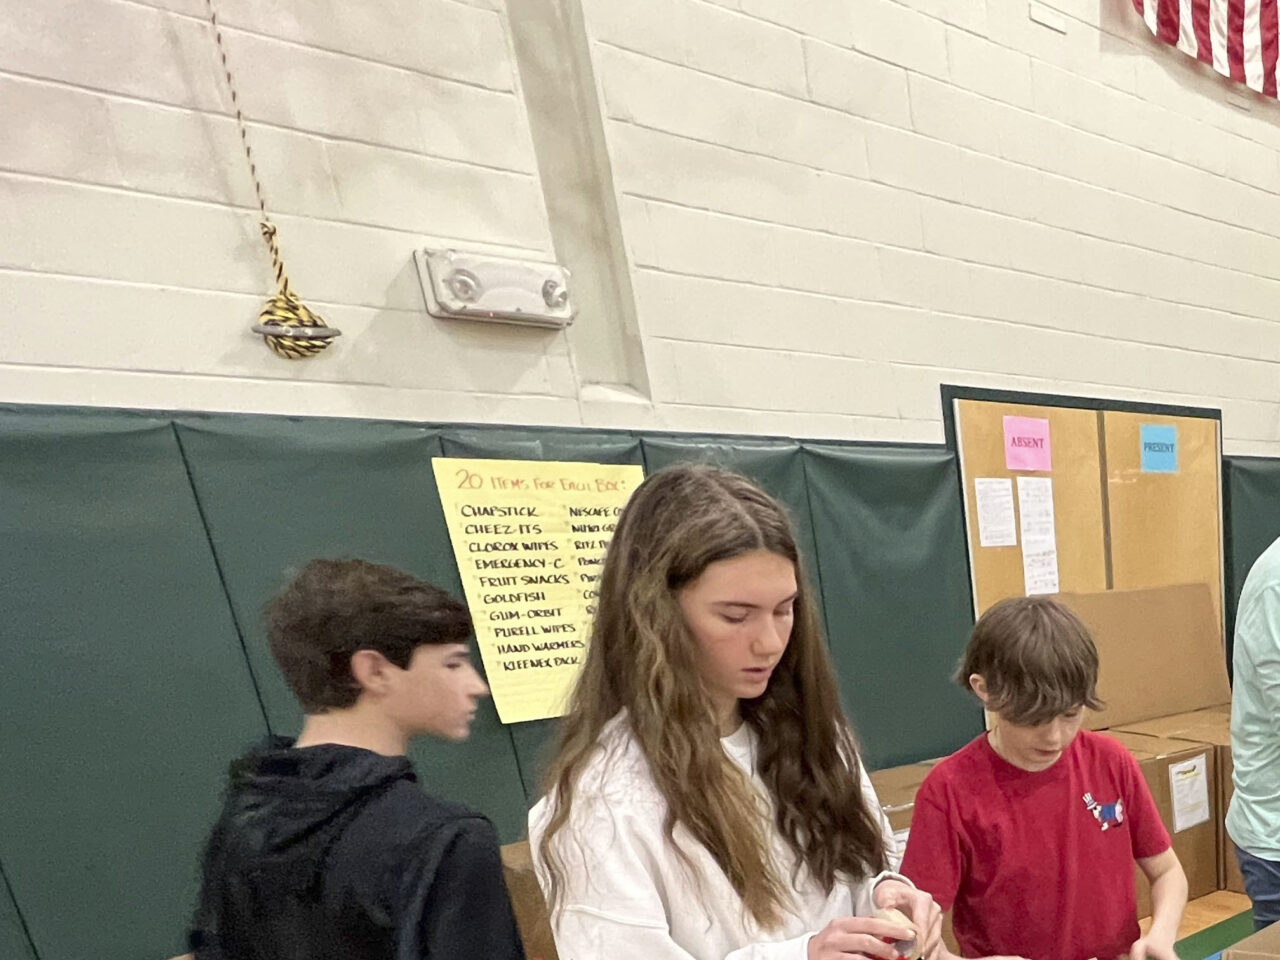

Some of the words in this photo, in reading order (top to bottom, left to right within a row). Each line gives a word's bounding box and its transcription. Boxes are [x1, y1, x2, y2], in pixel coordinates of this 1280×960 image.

[1010, 436, 1044, 449] ABSENT
[1143, 442, 1175, 453] PRESENT
[455, 468, 483, 490] 20
[460, 504, 539, 517] CHAPSTICK
[469, 542, 518, 553] CLOROX
[521, 541, 559, 551] WIPES
[479, 576, 518, 588] FRUIT
[520, 574, 570, 586] SNACKS
[483, 592, 546, 605] GOLDFISH
[494, 625, 540, 638] PURELL
[541, 623, 576, 634] WIPES
[497, 643, 531, 655] HAND
[531, 640, 586, 652] WARMERS
[503, 658, 553, 671] KLEENEX
